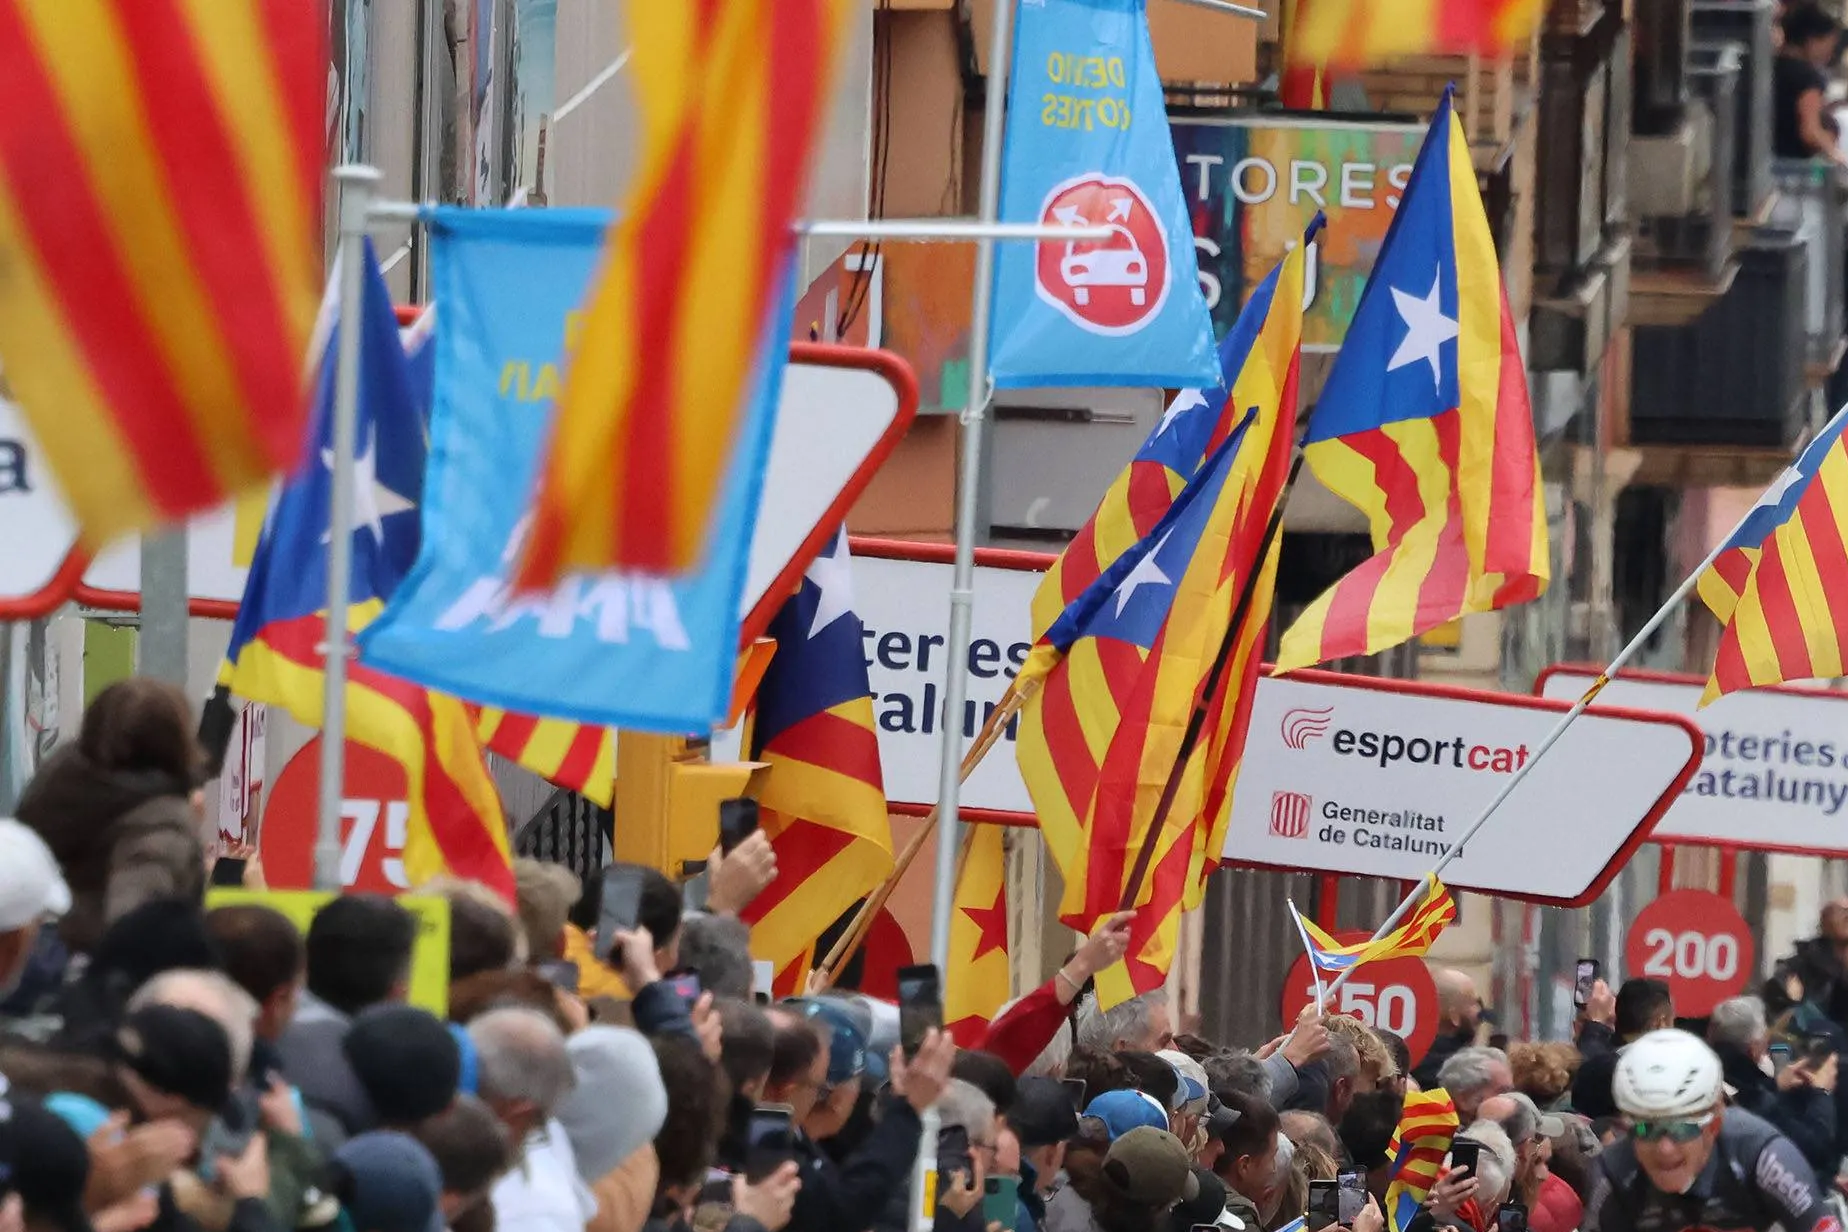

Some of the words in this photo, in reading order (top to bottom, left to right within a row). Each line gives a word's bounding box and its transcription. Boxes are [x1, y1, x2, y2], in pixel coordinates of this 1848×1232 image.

[1185, 153, 1415, 210] TORES
[1332, 727, 1529, 774] esportcat
[1703, 729, 1836, 768] oteries
[1318, 824, 1346, 845] de
[1321, 800, 1445, 833] Generalitat
[337, 799, 412, 889] 75
[1643, 927, 1738, 981] 200
